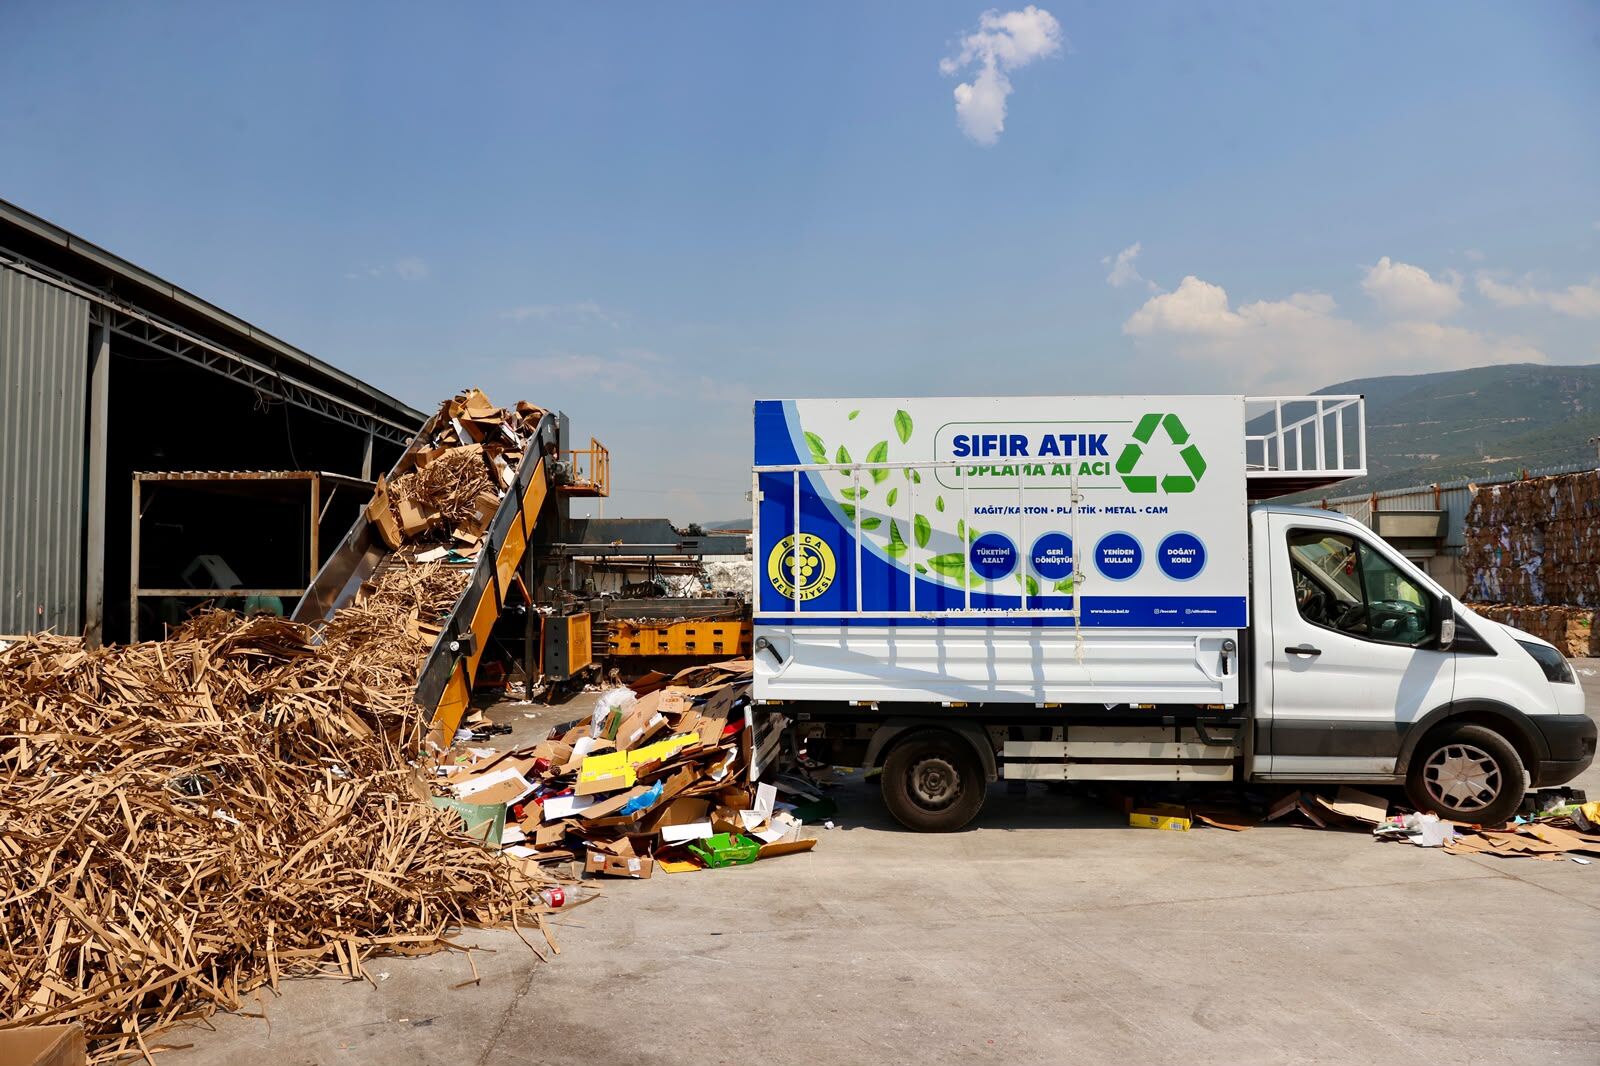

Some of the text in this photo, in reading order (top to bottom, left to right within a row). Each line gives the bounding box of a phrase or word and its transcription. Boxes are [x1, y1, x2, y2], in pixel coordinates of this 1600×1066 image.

[953, 434, 1109, 458] SIFIR ATIK
[1105, 506, 1137, 514] METAL
[1145, 506, 1168, 514] CAM
[781, 536, 822, 549] BCA
[976, 547, 1010, 556] TÜKETİMİ
[1046, 547, 1064, 556] GERİ
[1103, 547, 1135, 556] YENİDEN
[1167, 547, 1196, 556] DOĞAYI
